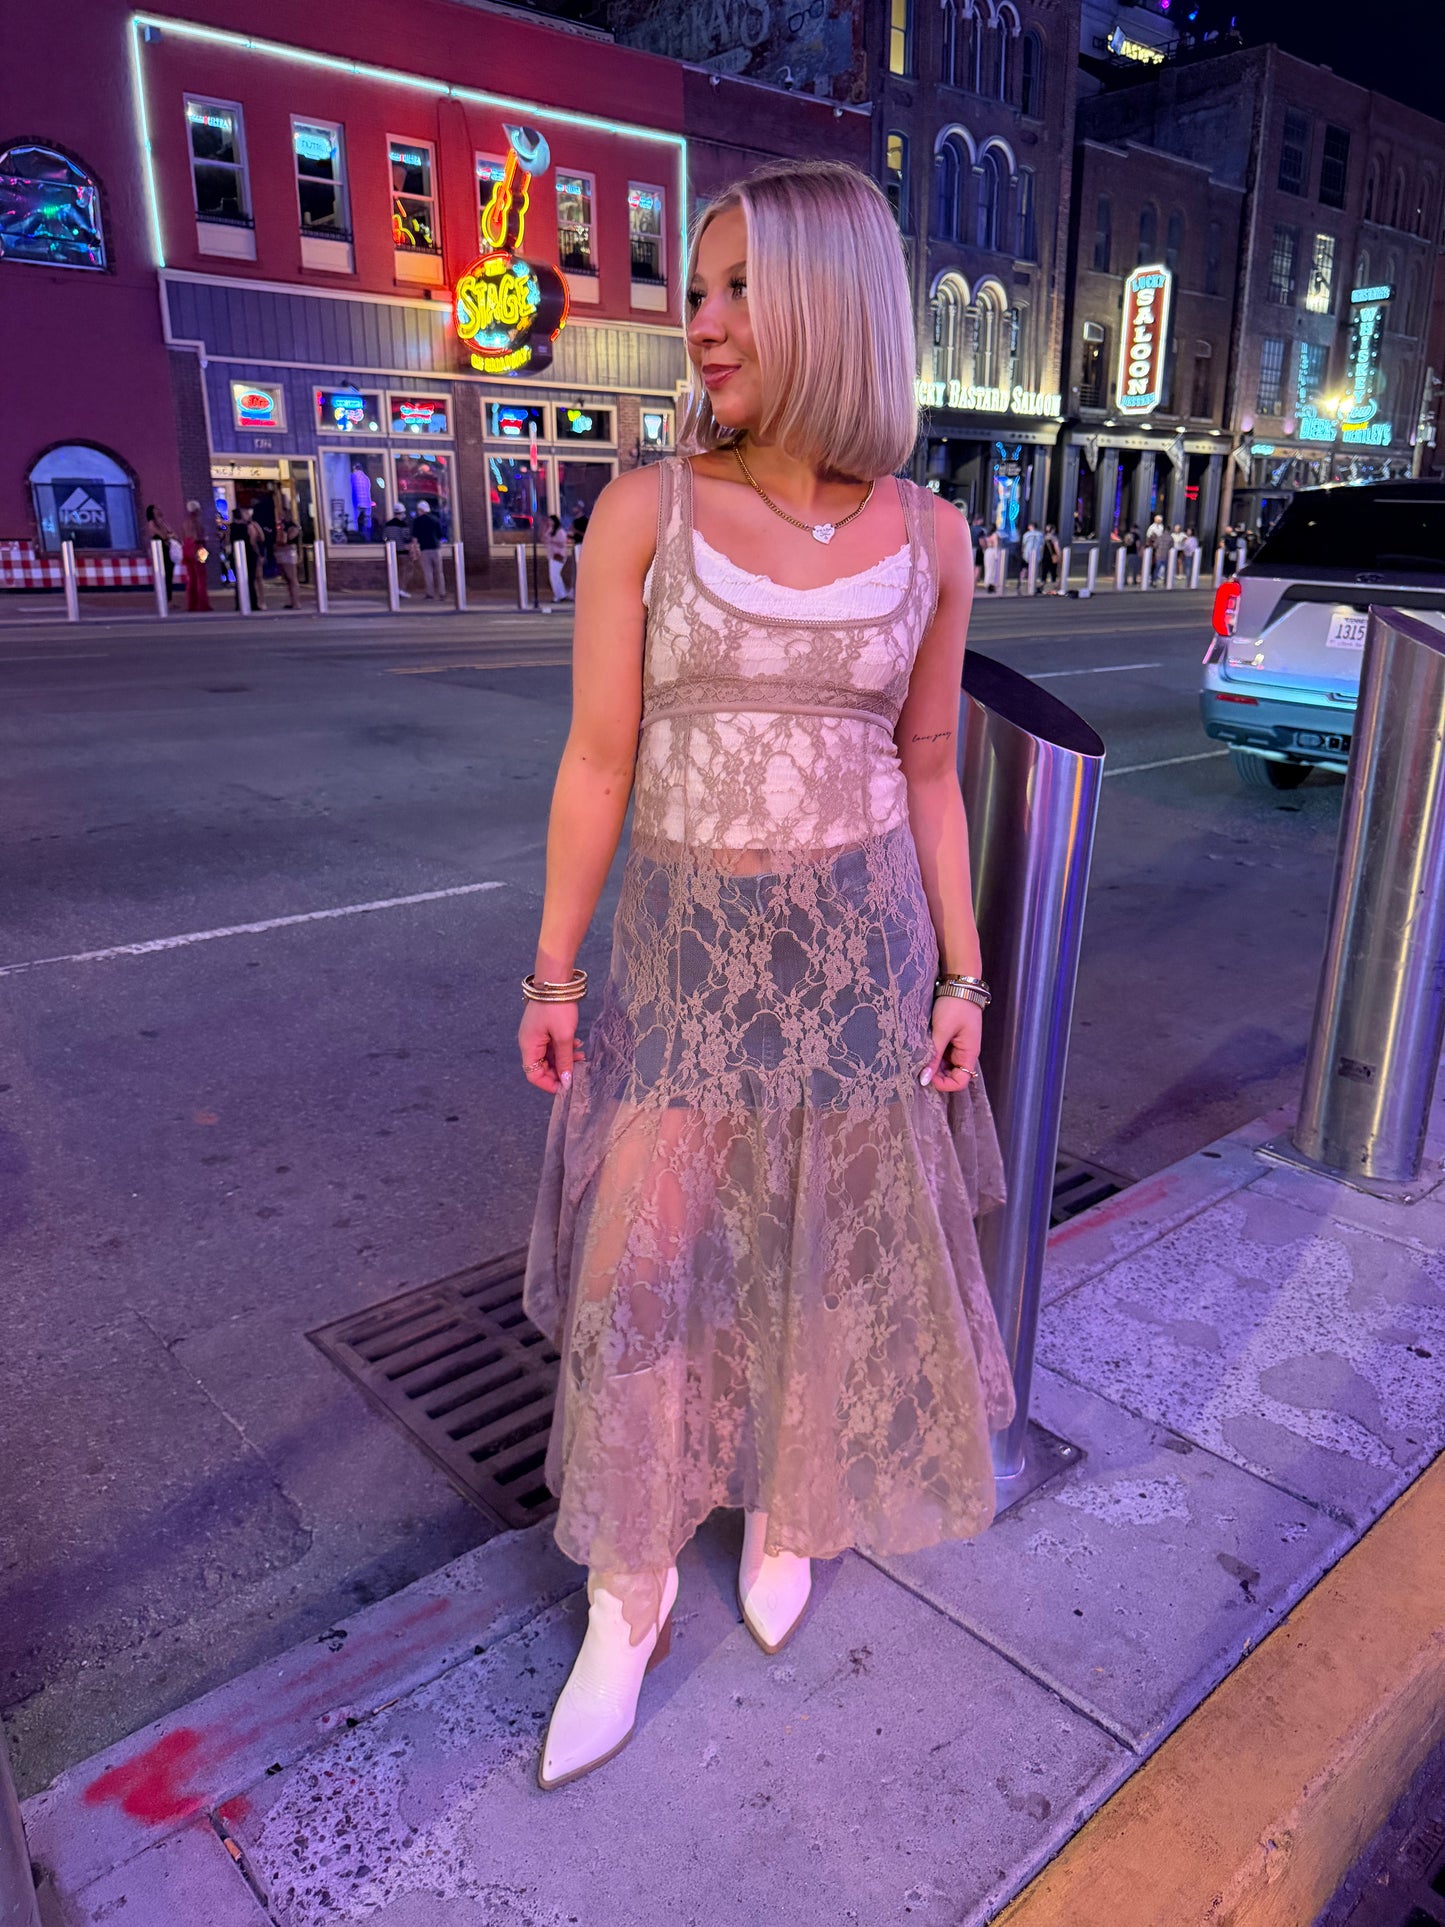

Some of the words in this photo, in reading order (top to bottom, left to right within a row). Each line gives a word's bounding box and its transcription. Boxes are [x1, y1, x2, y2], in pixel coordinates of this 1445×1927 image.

[1131, 274, 1167, 293] LUCKY
[456, 273, 537, 339] STAGE
[1127, 288, 1156, 396] SALOON
[1353, 305, 1379, 404] WHISKEY
[912, 379, 946, 408] UCKY
[948, 379, 1010, 414] BASTARD
[1011, 385, 1062, 417] SALOON
[59, 510, 106, 524] IKON
[1334, 624, 1366, 641] 1315
